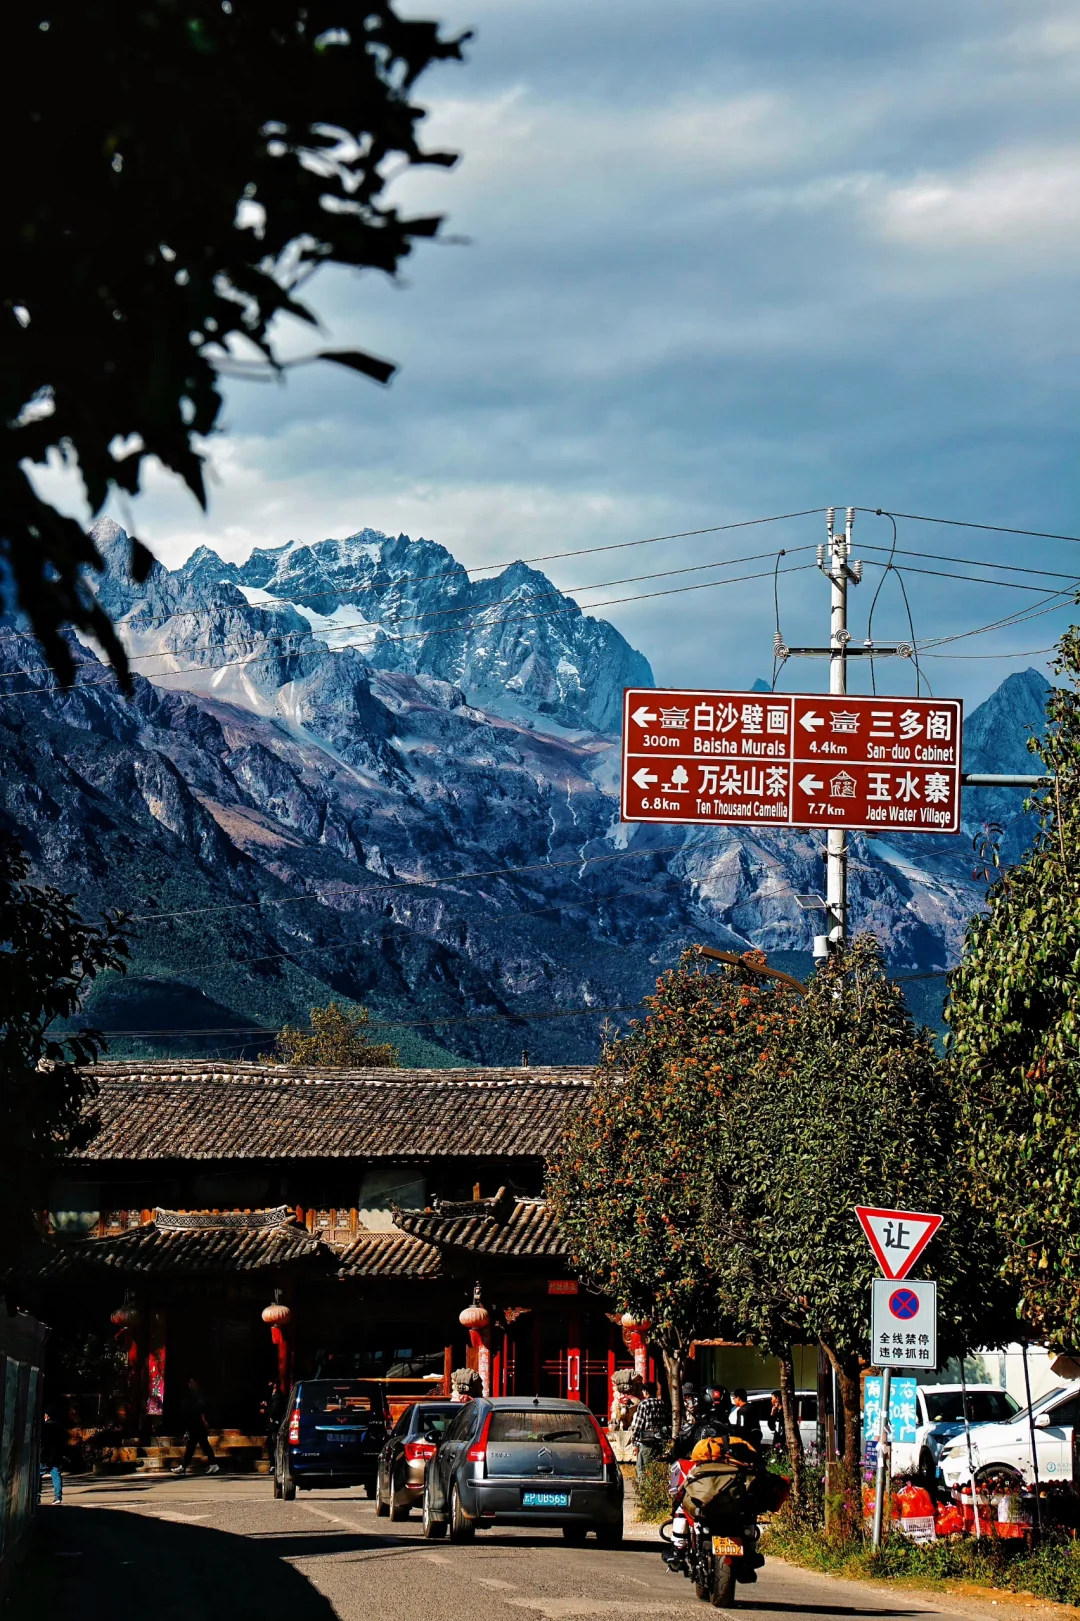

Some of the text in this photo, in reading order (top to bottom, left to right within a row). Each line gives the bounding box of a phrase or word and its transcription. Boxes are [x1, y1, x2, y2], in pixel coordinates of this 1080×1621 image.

[694, 702, 789, 735] 白沙壁画
[869, 708, 952, 741] 三多阁
[643, 735, 680, 747] 300m
[693, 737, 786, 756] Baisha Murals
[809, 741, 848, 754] 4.4km
[866, 742, 954, 762] San-duo Cabinet
[697, 765, 788, 797] 万朵山茶
[866, 771, 950, 803] 玉水寨
[641, 797, 680, 810] 6.8km
[696, 799, 788, 817] Ten Thousand Camellia
[808, 803, 845, 815] 7.7km
[866, 805, 951, 827] Jade Water Village
[883, 1221, 910, 1250] 让
[879, 1332, 929, 1345] 全线禁停
[879, 1347, 929, 1360] 违停抓拍
